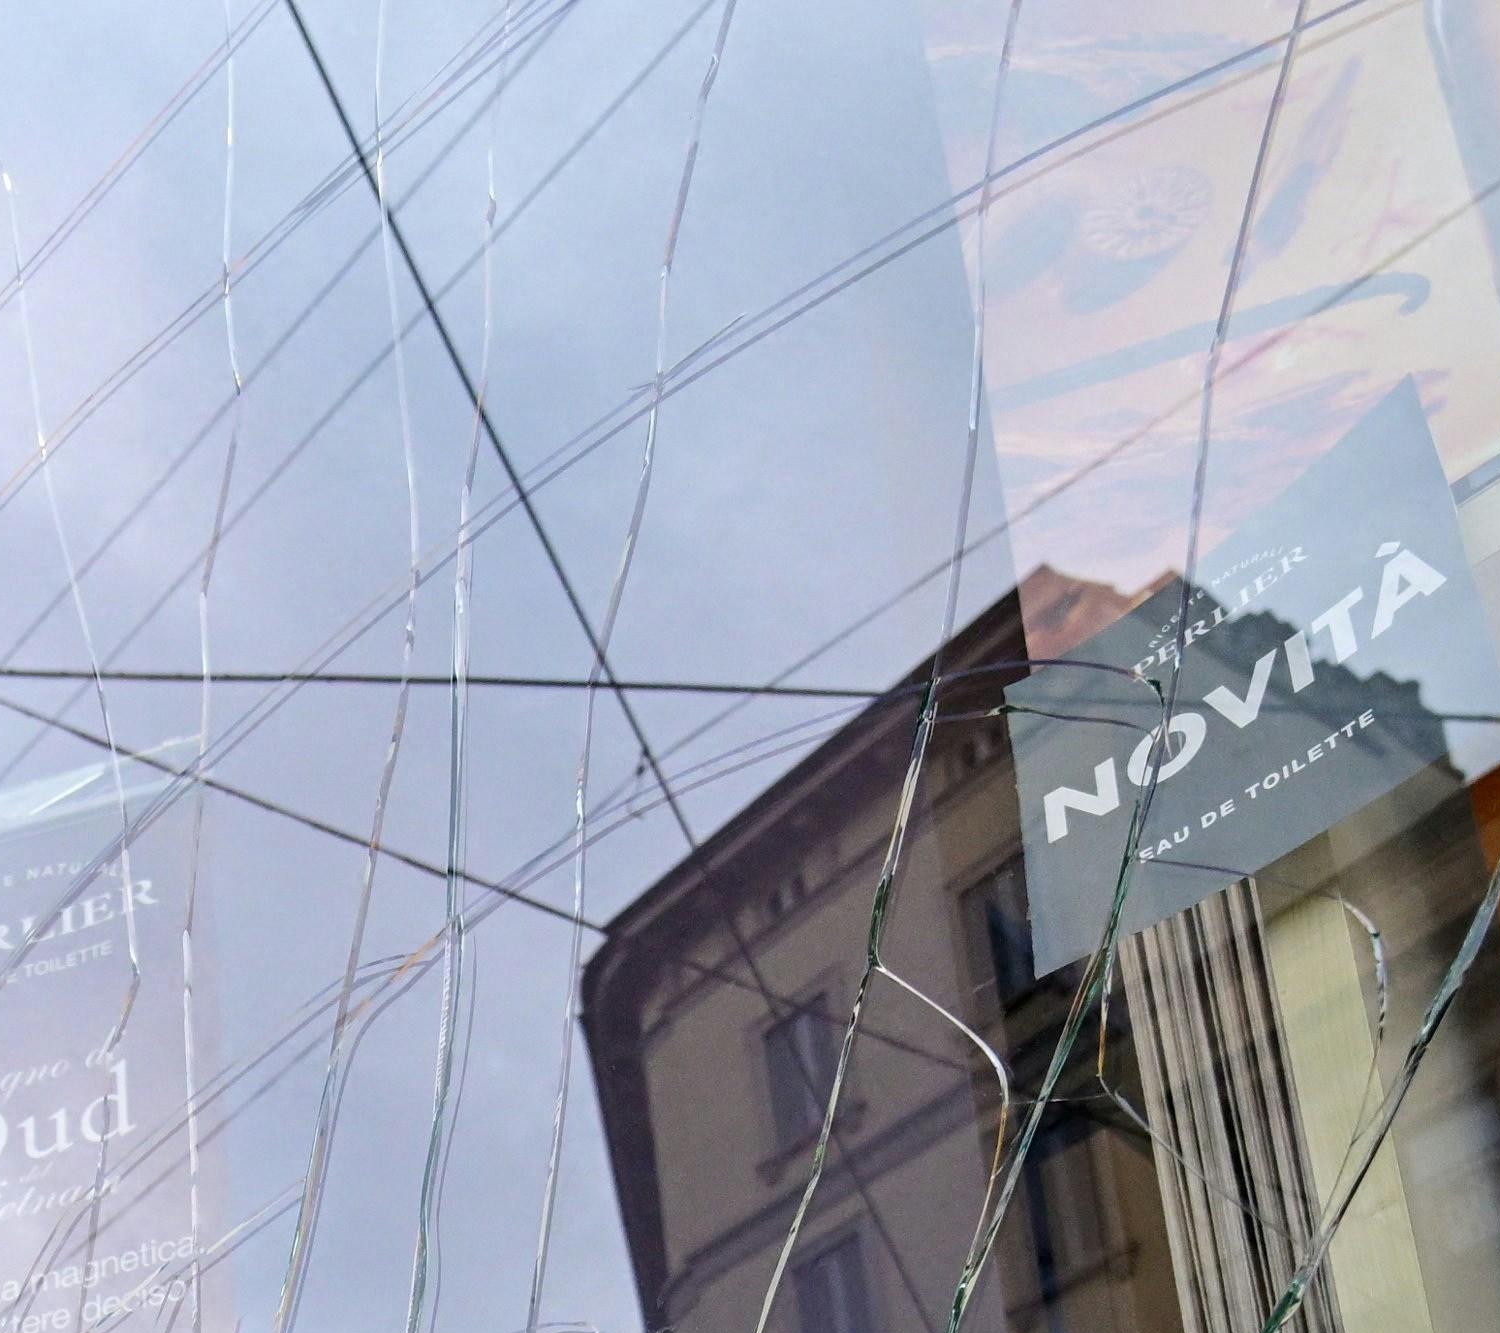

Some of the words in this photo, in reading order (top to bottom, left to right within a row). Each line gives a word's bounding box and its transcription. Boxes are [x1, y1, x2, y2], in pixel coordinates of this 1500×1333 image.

[1129, 545, 1311, 683] PERLIER
[1148, 589, 1207, 649] RICETE
[1211, 545, 1284, 588] NATURALI
[1042, 541, 1448, 844] NOVITÀ
[1138, 826, 1190, 865] EAU
[1199, 798, 1236, 831] DE
[1244, 708, 1377, 800] TOILETTE
[23, 939, 113, 979] TOILETTE
